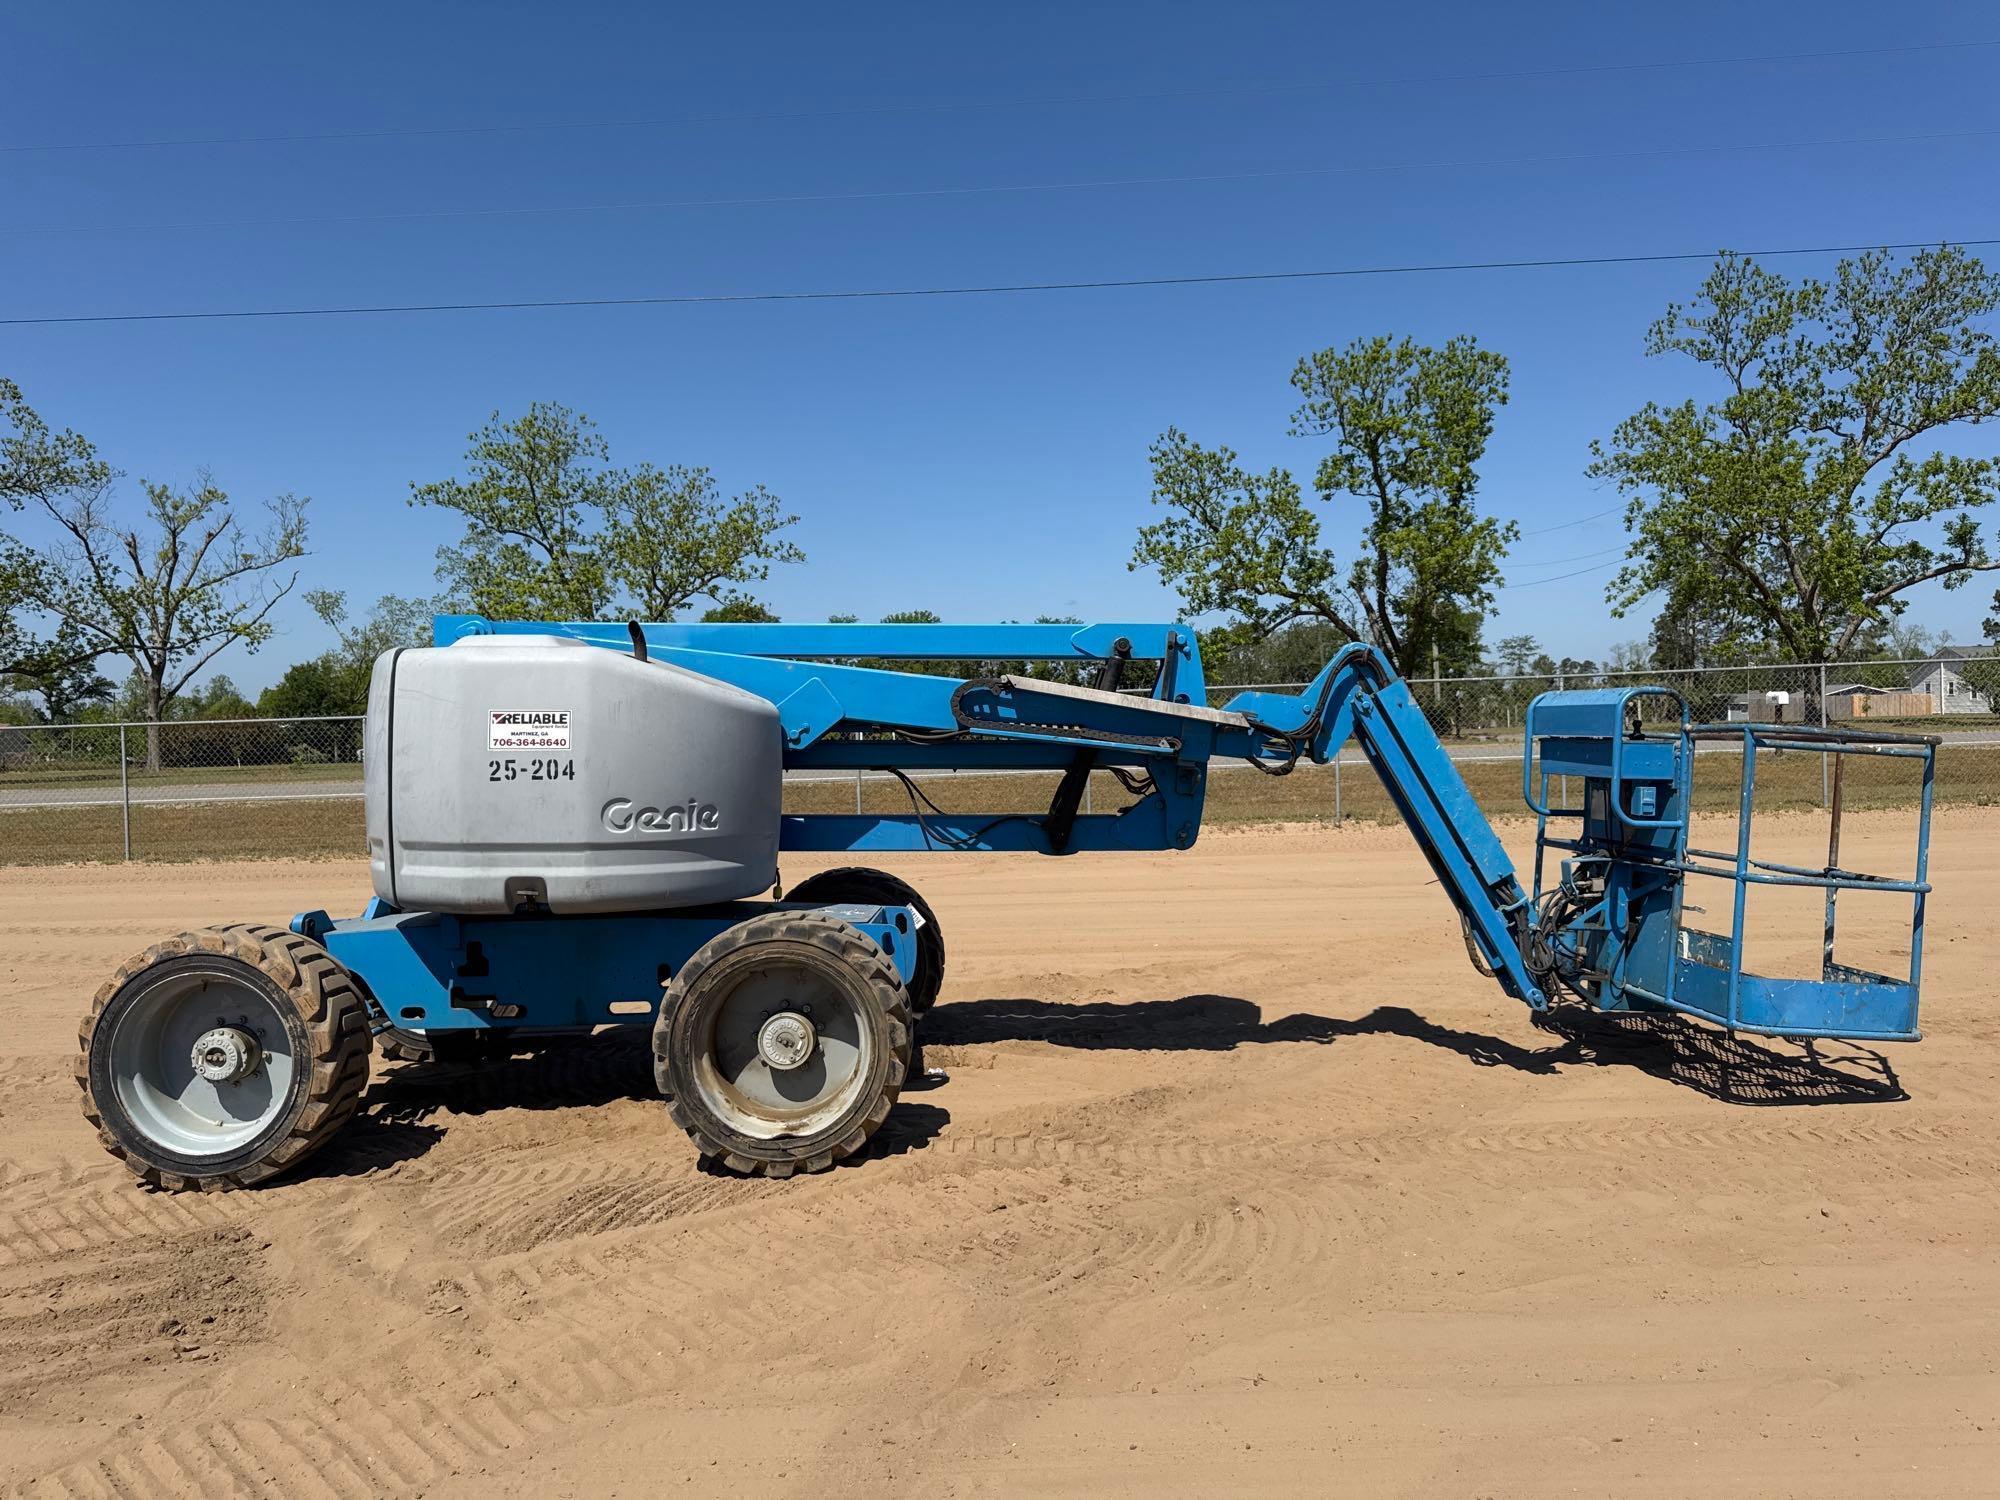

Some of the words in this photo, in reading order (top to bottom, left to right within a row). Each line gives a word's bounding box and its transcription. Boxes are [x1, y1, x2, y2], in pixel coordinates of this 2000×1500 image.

[502, 713, 568, 724] RELIABLE
[489, 759, 575, 782] 25-204
[600, 797, 719, 834] Genie
